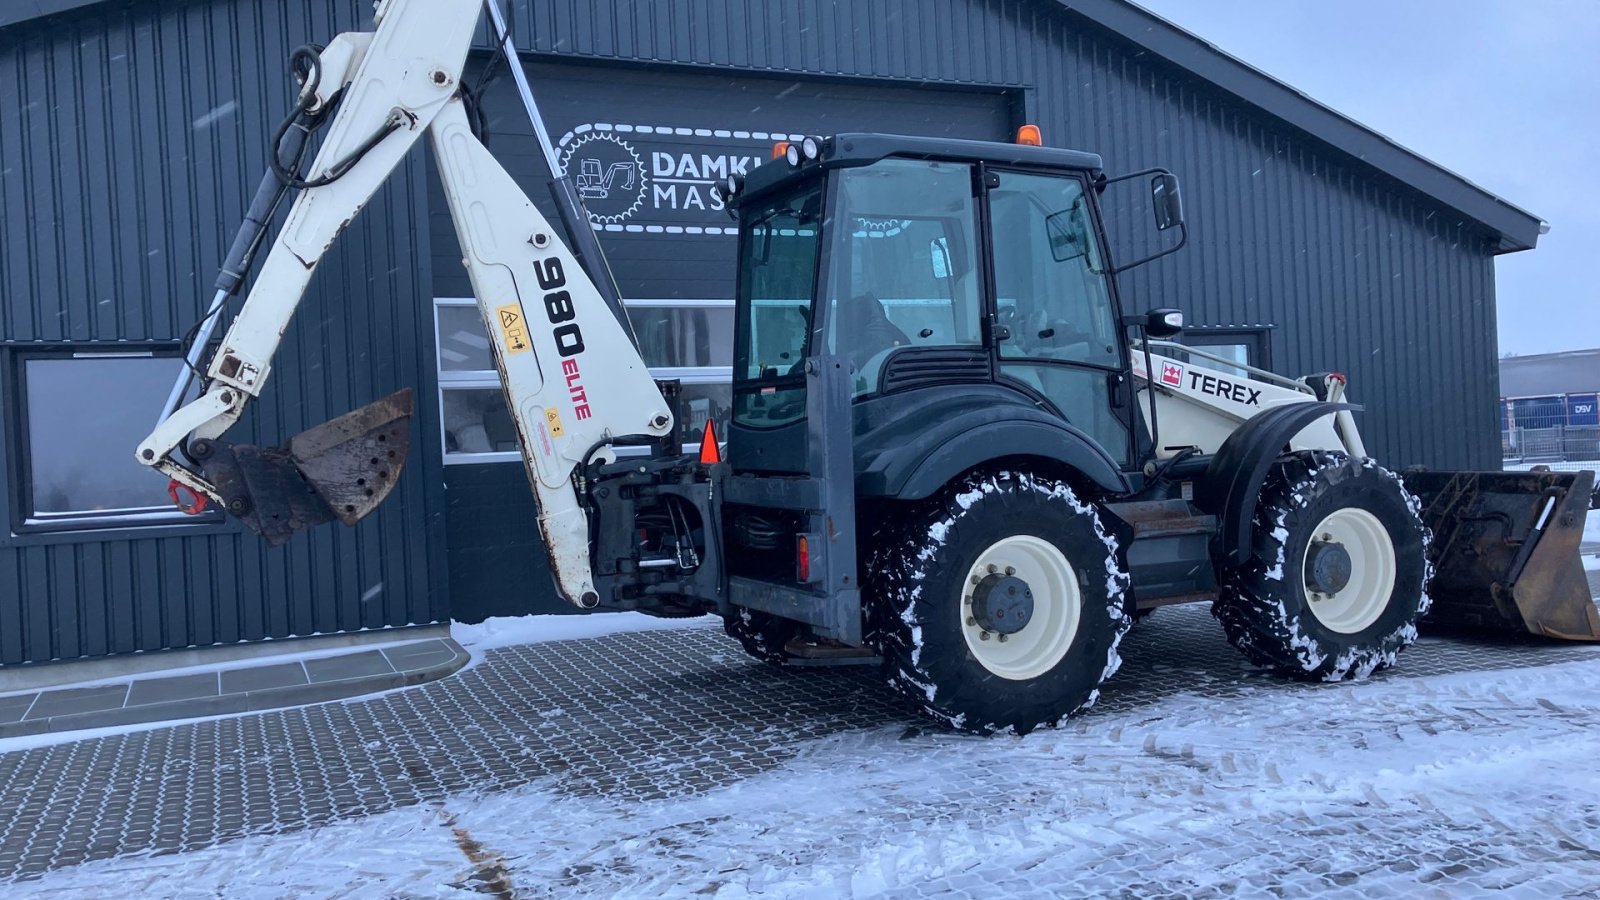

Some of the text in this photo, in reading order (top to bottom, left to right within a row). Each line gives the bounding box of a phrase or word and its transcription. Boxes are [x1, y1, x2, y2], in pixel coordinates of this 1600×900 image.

[533, 256, 592, 421] 980 ELITE
[1188, 370, 1262, 406] TEREX
